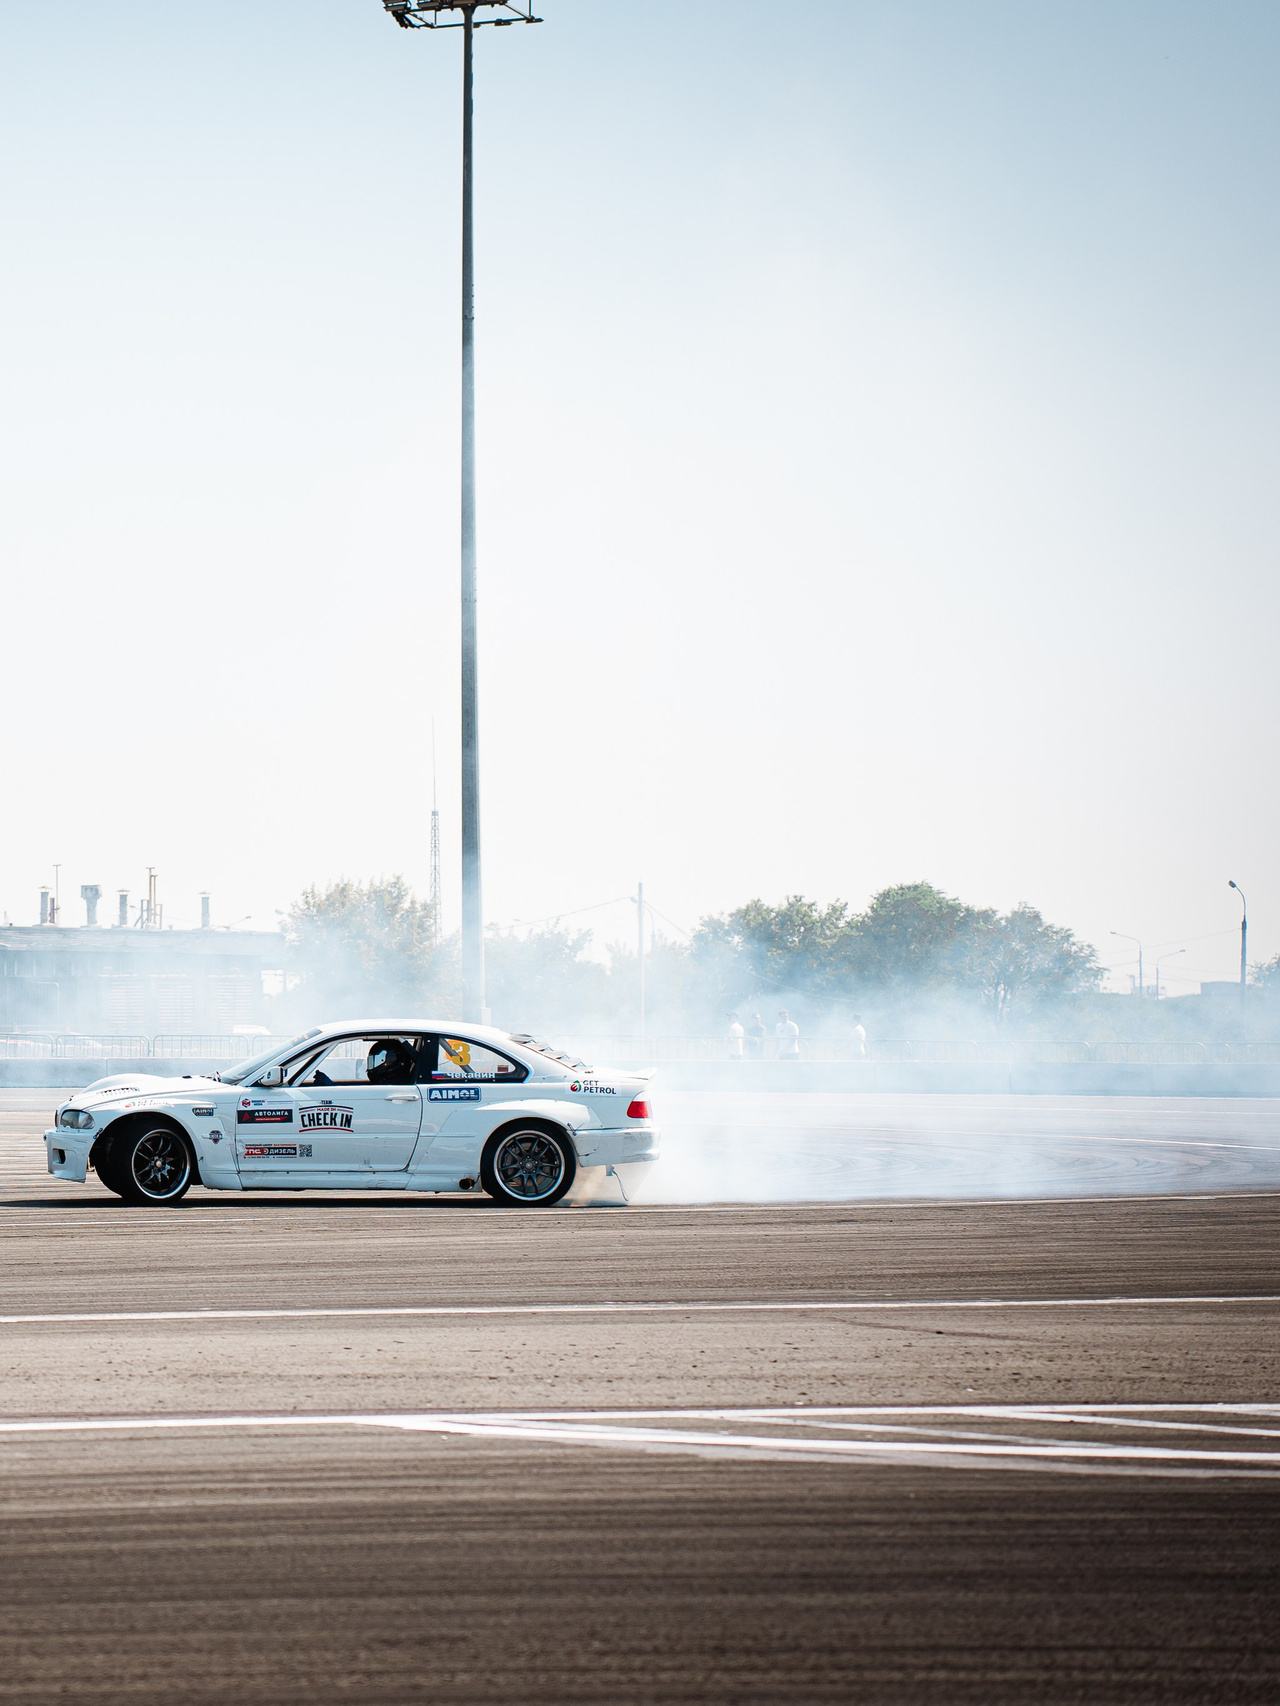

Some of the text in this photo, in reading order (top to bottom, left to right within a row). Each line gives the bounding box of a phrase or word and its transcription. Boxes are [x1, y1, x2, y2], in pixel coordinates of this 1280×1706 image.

[451, 1042, 470, 1066] 3
[430, 1089, 479, 1099] AIMOL
[583, 1086, 617, 1095] PETROL
[300, 1112, 353, 1128] CHECK IN
